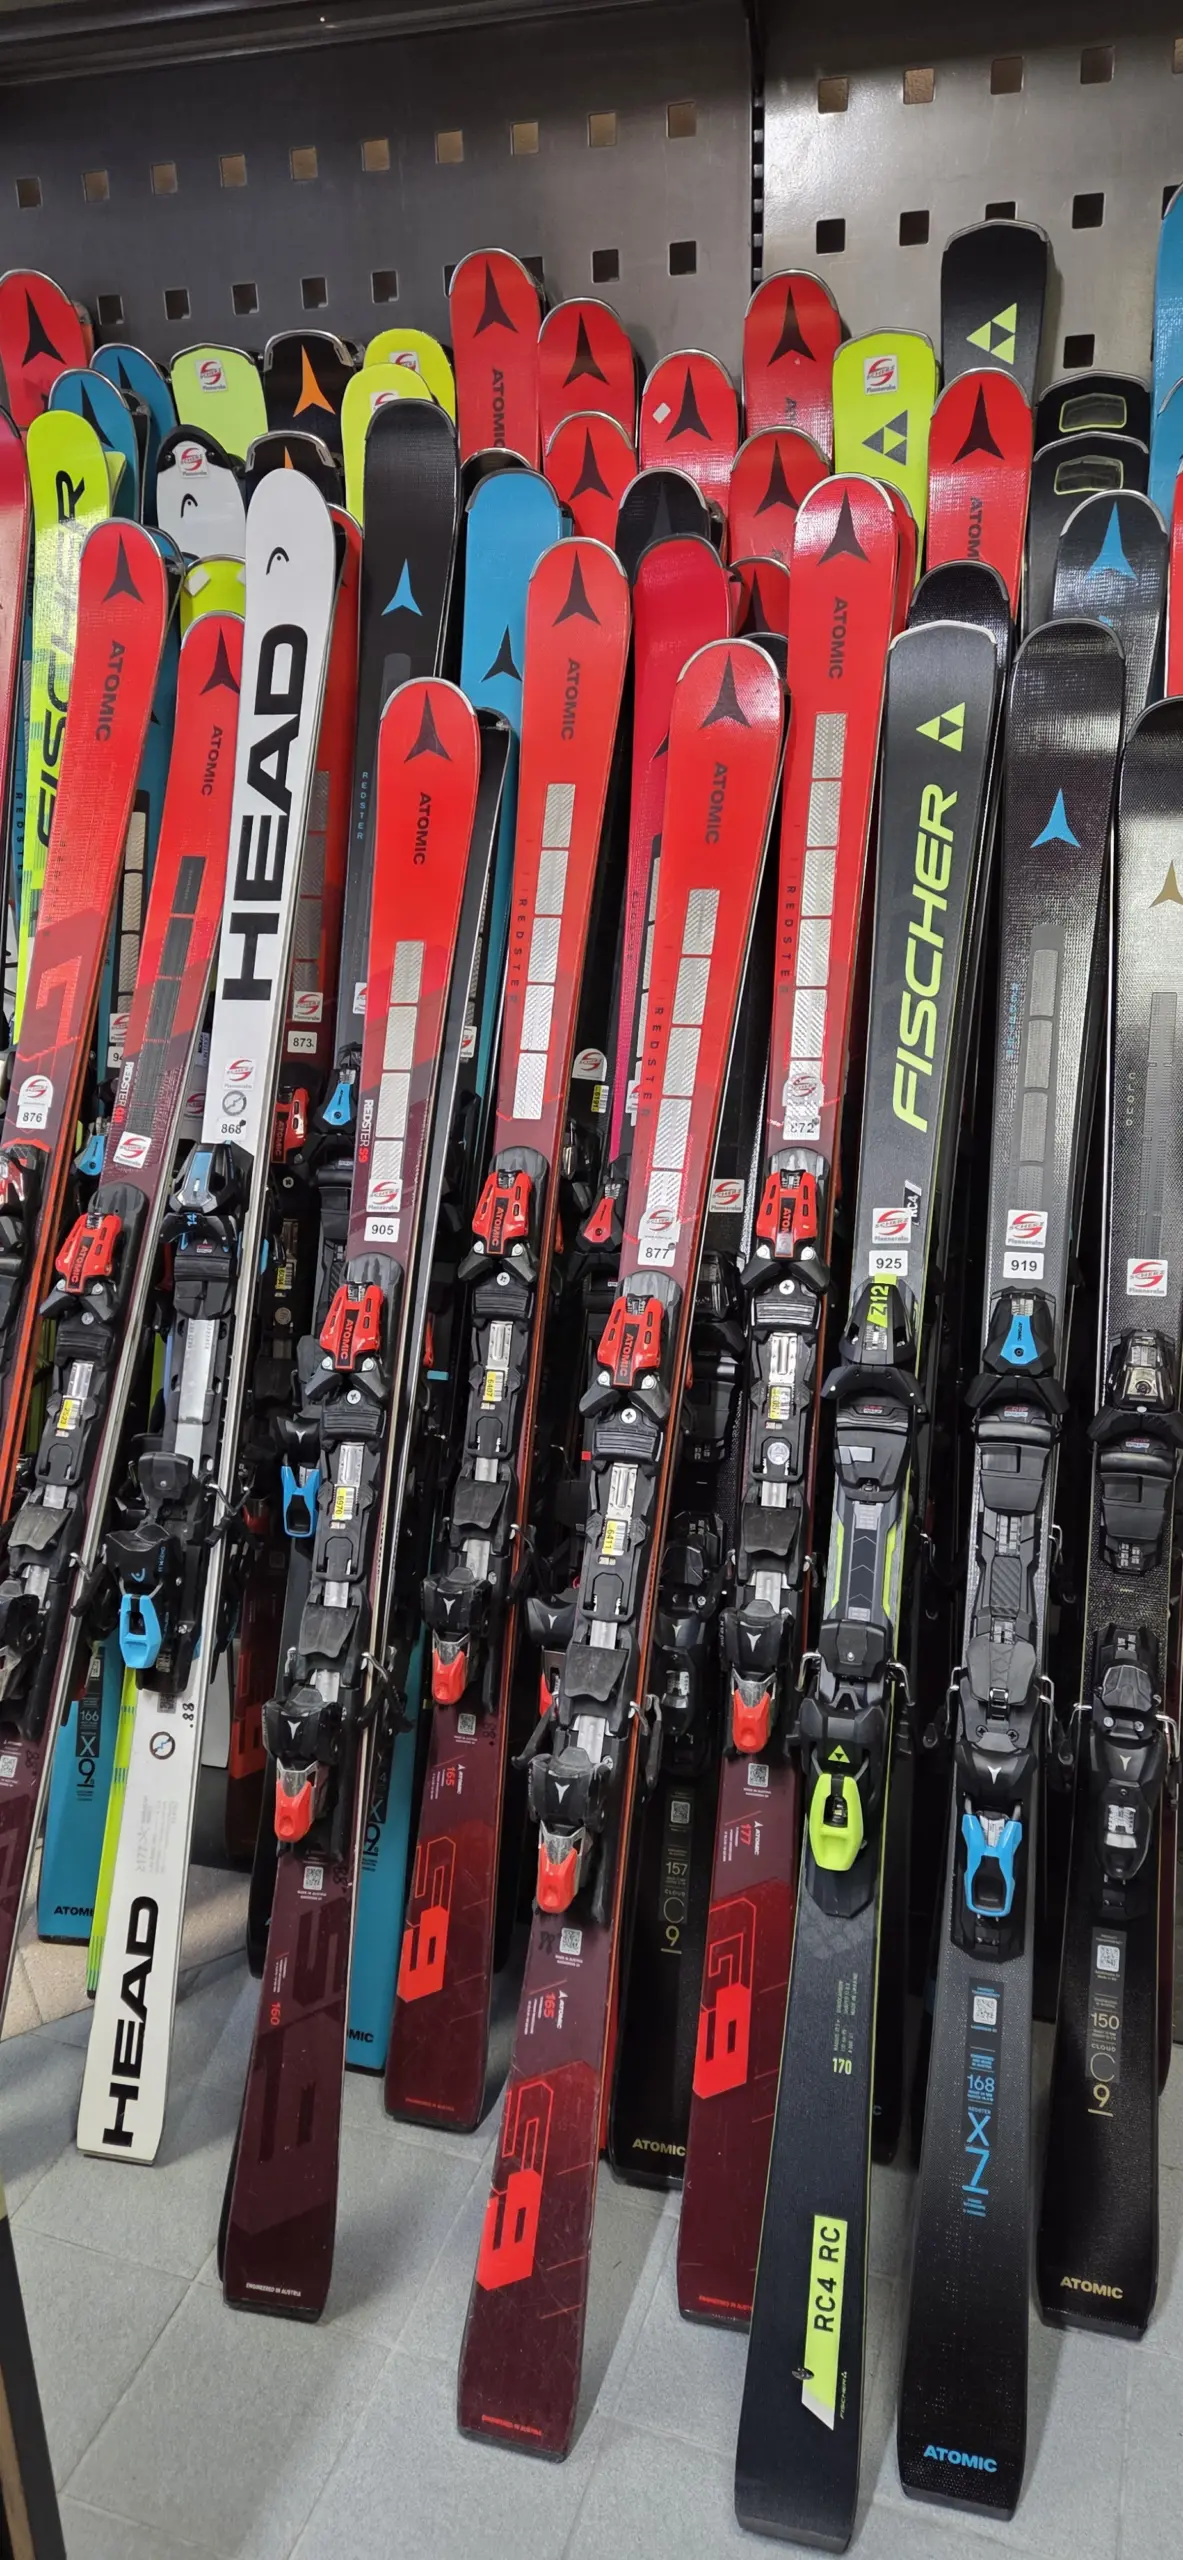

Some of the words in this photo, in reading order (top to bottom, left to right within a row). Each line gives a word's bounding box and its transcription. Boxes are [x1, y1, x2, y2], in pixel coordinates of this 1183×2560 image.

[492, 368, 506, 449] ATOMIC
[967, 496, 984, 561] ATOM
[829, 596, 848, 680] ATOMIC
[96, 640, 126, 742] ATOMIC
[561, 658, 581, 741] ATOMIC
[202, 725, 223, 797] ATOMIC
[222, 624, 309, 1001] HEAD
[357, 771, 369, 840] REDSTER
[705, 762, 728, 845] ATOMIC
[413, 791, 432, 865] ATOMIC
[510, 898, 528, 1004] REDSTER
[779, 885, 797, 993] REDSTER
[892, 783, 958, 1133] FISCHER
[293, 1038, 312, 1048] 873
[640, 1006, 664, 1116] REDSTER
[1126, 1072, 1136, 1126] CLOUD
[22, 1112, 43, 1123] 876
[221, 1124, 241, 1134] 868
[362, 1099, 374, 1146] REDSTER
[790, 1122, 814, 1134] 872
[371, 1225, 394, 1236] 905
[491, 1206, 504, 1246] ATOMIC
[71, 1245, 88, 1283] ATOMIC
[645, 1248, 669, 1260] 877
[876, 1258, 902, 1269] 925
[1011, 1260, 1038, 1272] 919
[870, 1285, 890, 1316] Z12
[340, 1319, 353, 1360] ATOMIC
[619, 1335, 634, 1377] ATOMIC
[486, 1379, 494, 1398] 6407
[336, 1495, 345, 1515] 6970
[605, 1529, 614, 1549] 6411
[80, 1709, 100, 1722] 166
[81, 1736, 96, 1757] X
[446, 1767, 455, 1786] 165
[740, 1823, 752, 1846] 177
[666, 1861, 688, 1876] 157
[664, 1888, 686, 1897] CLOUD
[663, 1896, 685, 1924] C
[665, 1925, 681, 1949] 9
[270, 2002, 281, 2026] 160
[543, 1992, 556, 2019] 165
[557, 1999, 565, 2029] ATOMIC
[102, 1896, 159, 2147] HEAD
[1090, 2012, 1120, 2031] 150
[1091, 2043, 1117, 2053] CLOUD
[832, 2058, 852, 2075] 170
[1090, 2052, 1116, 2083] C
[967, 2074, 995, 2093] 168
[1092, 2083, 1111, 2109] 9
[966, 2111, 991, 2147] X
[632, 2138, 687, 2158] ATOMIC
[964, 2146, 990, 2187] 7
[819, 2226, 841, 2263] RC
[245, 2282, 275, 2293] ENGINEERED
[281, 2287, 302, 2297] AUSTRIA
[1060, 2276, 1124, 2299] ATOMIC
[813, 2277, 837, 2333] RC4
[923, 2444, 997, 2473] ATOMIC
